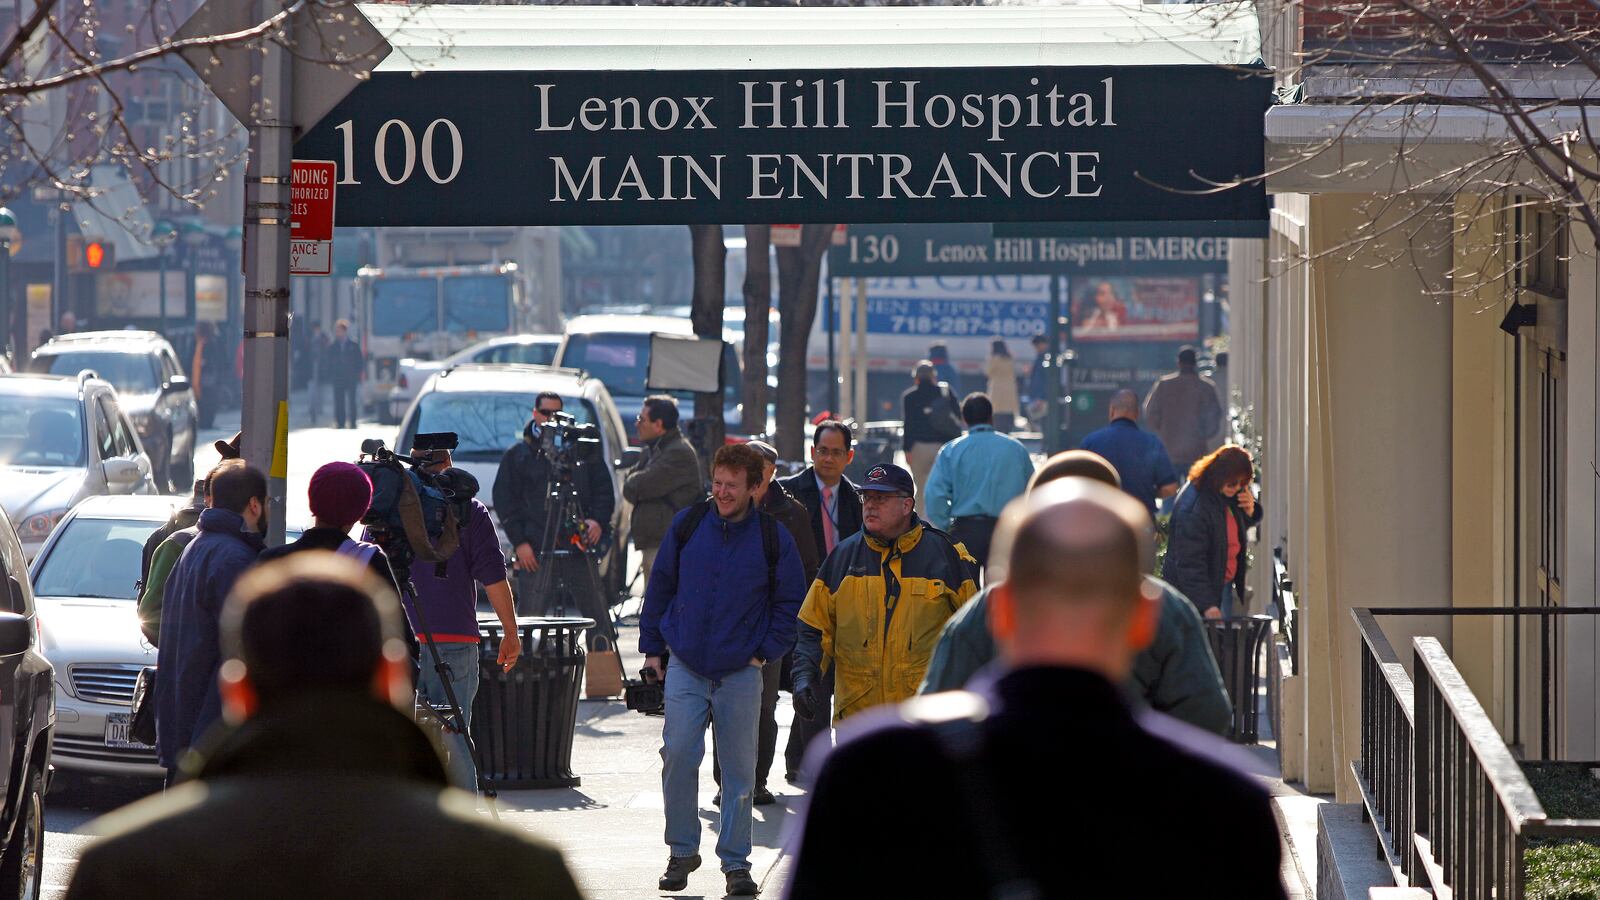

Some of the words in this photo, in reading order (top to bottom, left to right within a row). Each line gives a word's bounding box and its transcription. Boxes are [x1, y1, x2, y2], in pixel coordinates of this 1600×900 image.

[534, 83, 718, 133] Lenox
[738, 77, 850, 129] Hill
[871, 75, 1118, 142] Hospital
[335, 117, 464, 186] 100
[290, 168, 328, 185] NDING
[549, 154, 727, 203] MAIN
[746, 151, 1104, 201] ENTRANCE
[291, 243, 318, 255] ANCE
[850, 234, 900, 264] 130
[925, 239, 988, 263] Lenox
[994, 237, 1033, 262] Hill
[1038, 236, 1124, 267] Hospital
[1130, 236, 1230, 261] EMERGE
[890, 315, 1046, 335] 718-287-4800
[112, 723, 130, 741] DA
